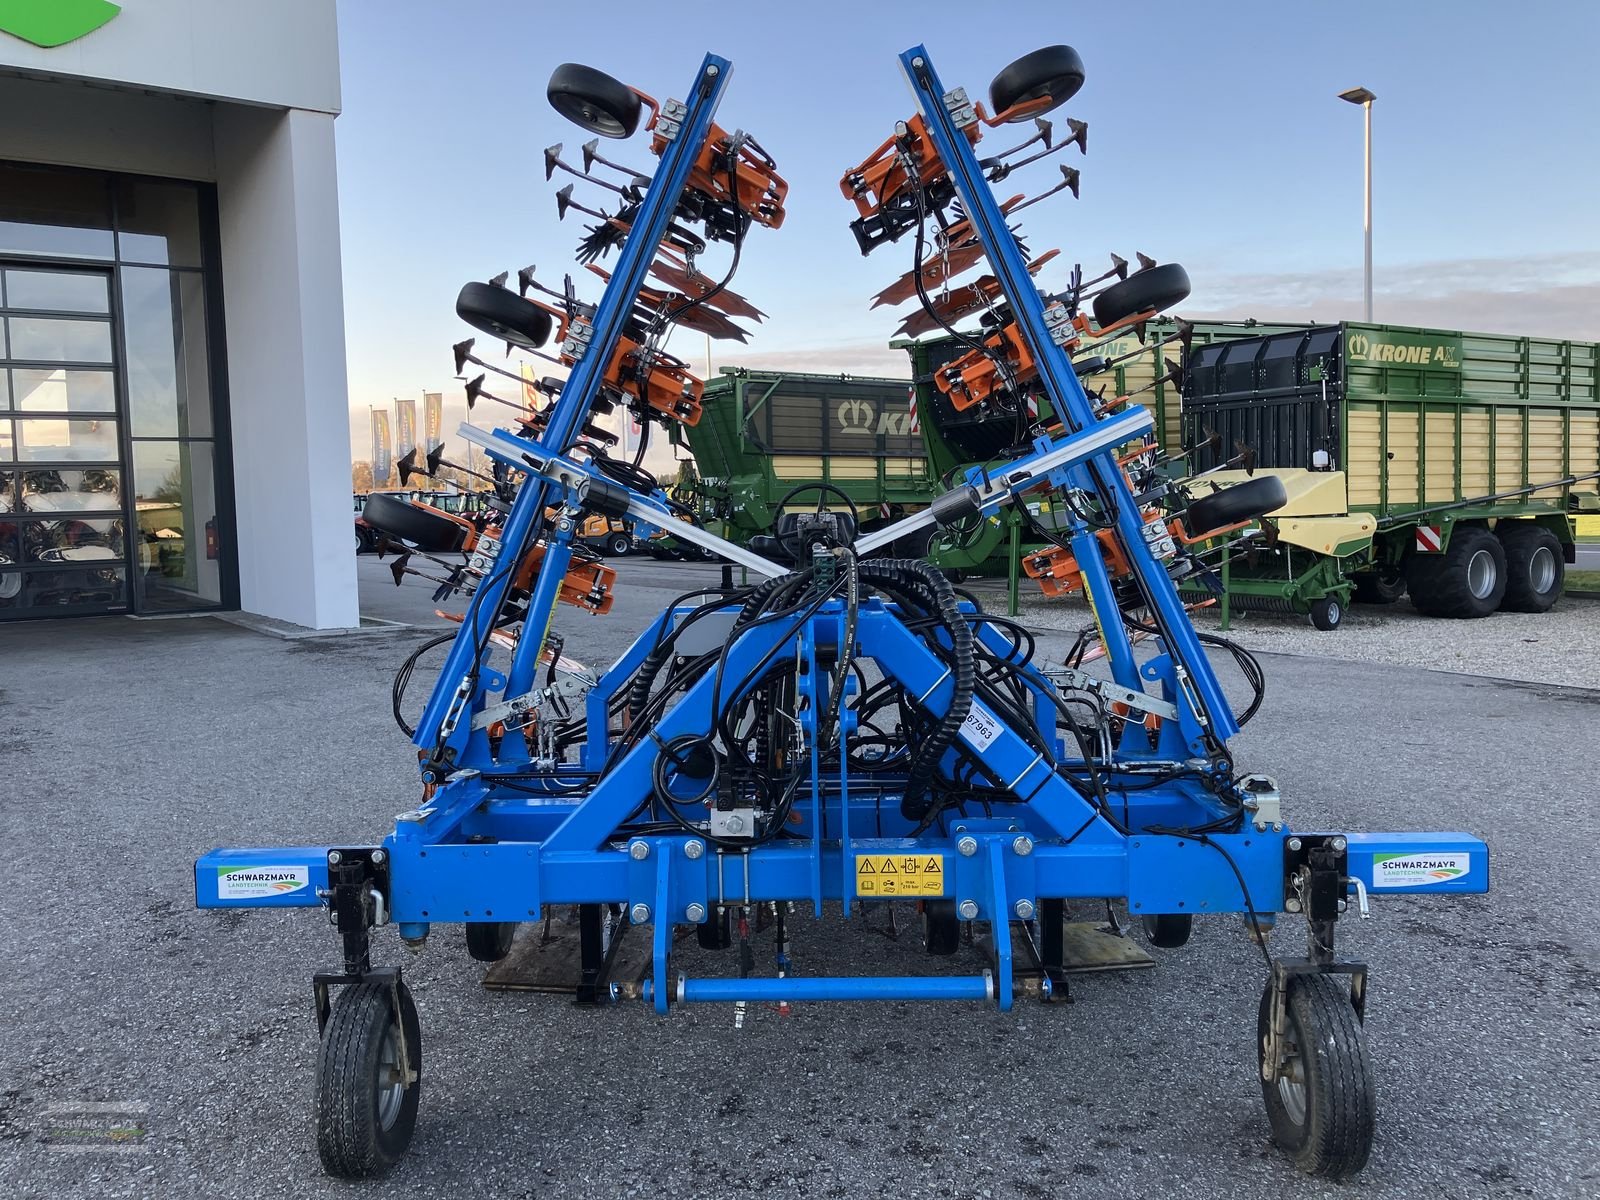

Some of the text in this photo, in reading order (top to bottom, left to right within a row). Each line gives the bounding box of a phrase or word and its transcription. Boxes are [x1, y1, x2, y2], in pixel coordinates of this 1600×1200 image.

[1369, 343, 1456, 364] KRONE AX
[966, 714, 993, 740] 67963
[1382, 861, 1456, 870] SCHWARZMAYR
[226, 873, 296, 882] SCHWARZMAYR
